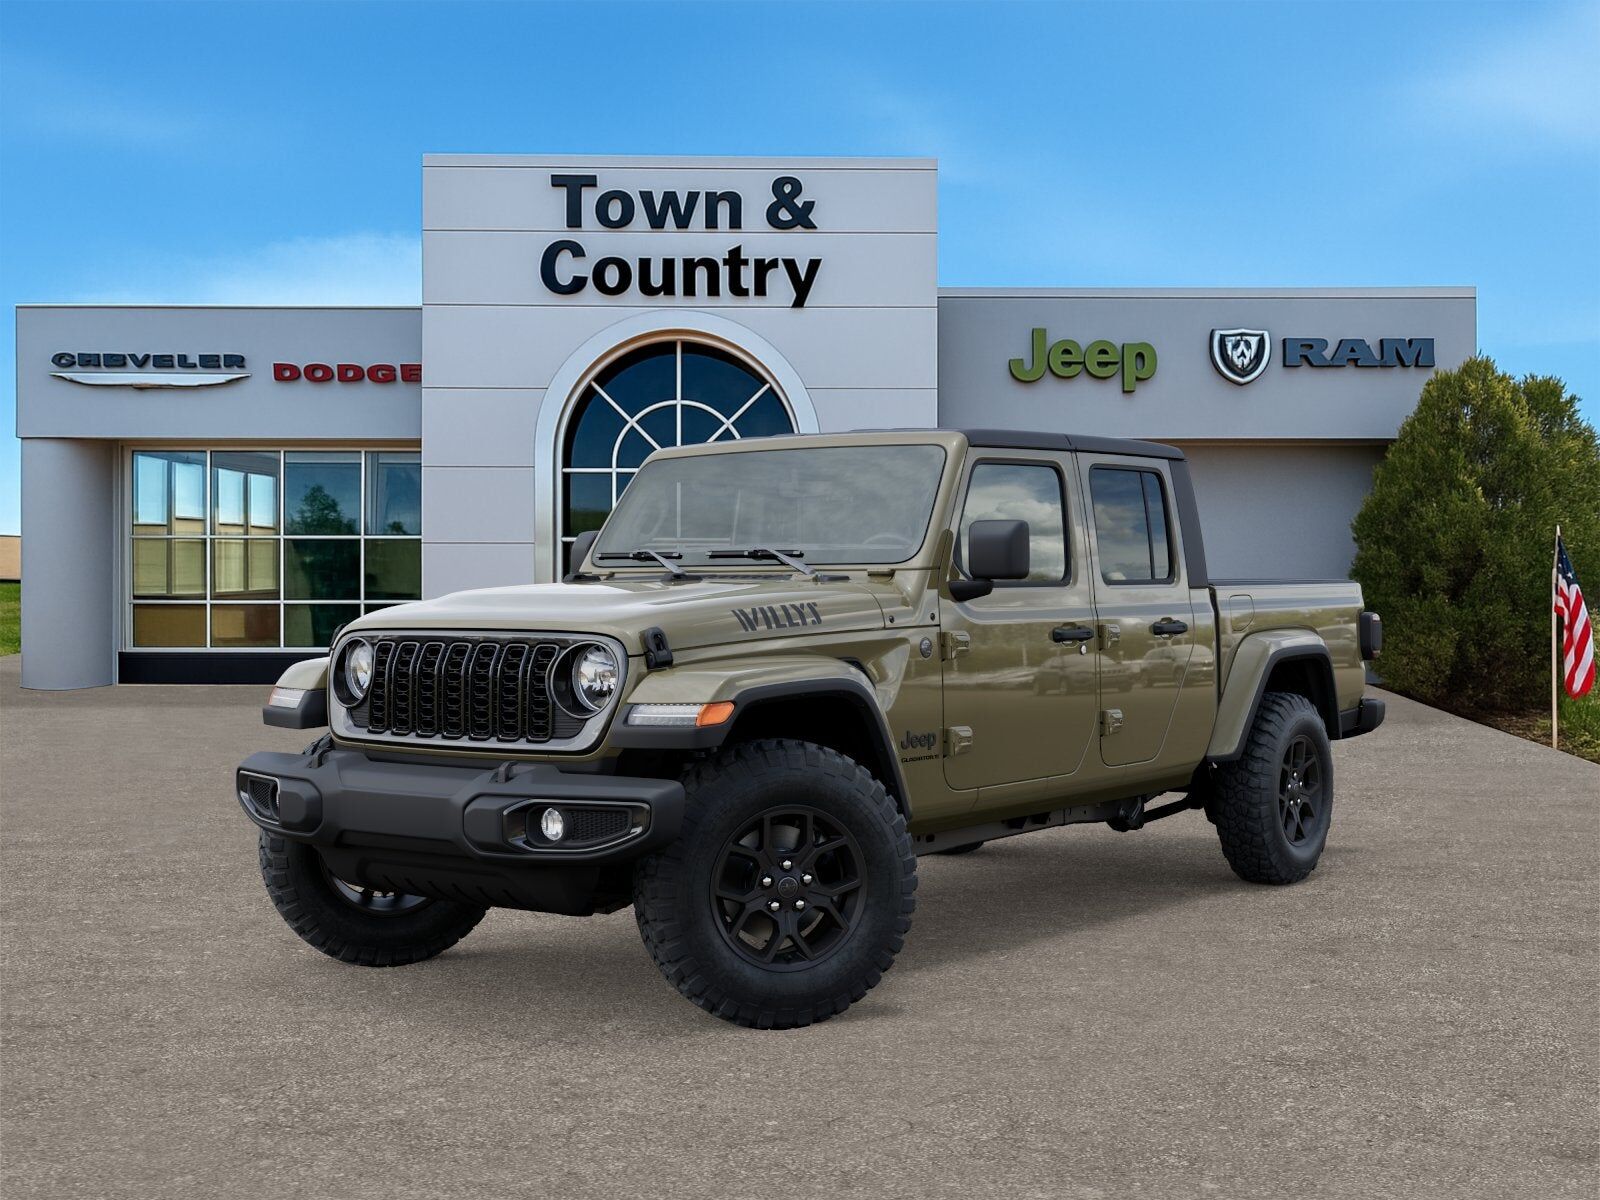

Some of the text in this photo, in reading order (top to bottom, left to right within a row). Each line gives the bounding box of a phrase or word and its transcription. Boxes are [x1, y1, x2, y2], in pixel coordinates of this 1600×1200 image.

[550, 174, 818, 230] Town &
[539, 239, 822, 309] Country
[1008, 327, 1158, 393] Jeep
[1282, 337, 1435, 368] RAM
[273, 362, 422, 383] DODGE
[731, 601, 822, 632] WILLYS
[900, 730, 937, 751] Jeep
